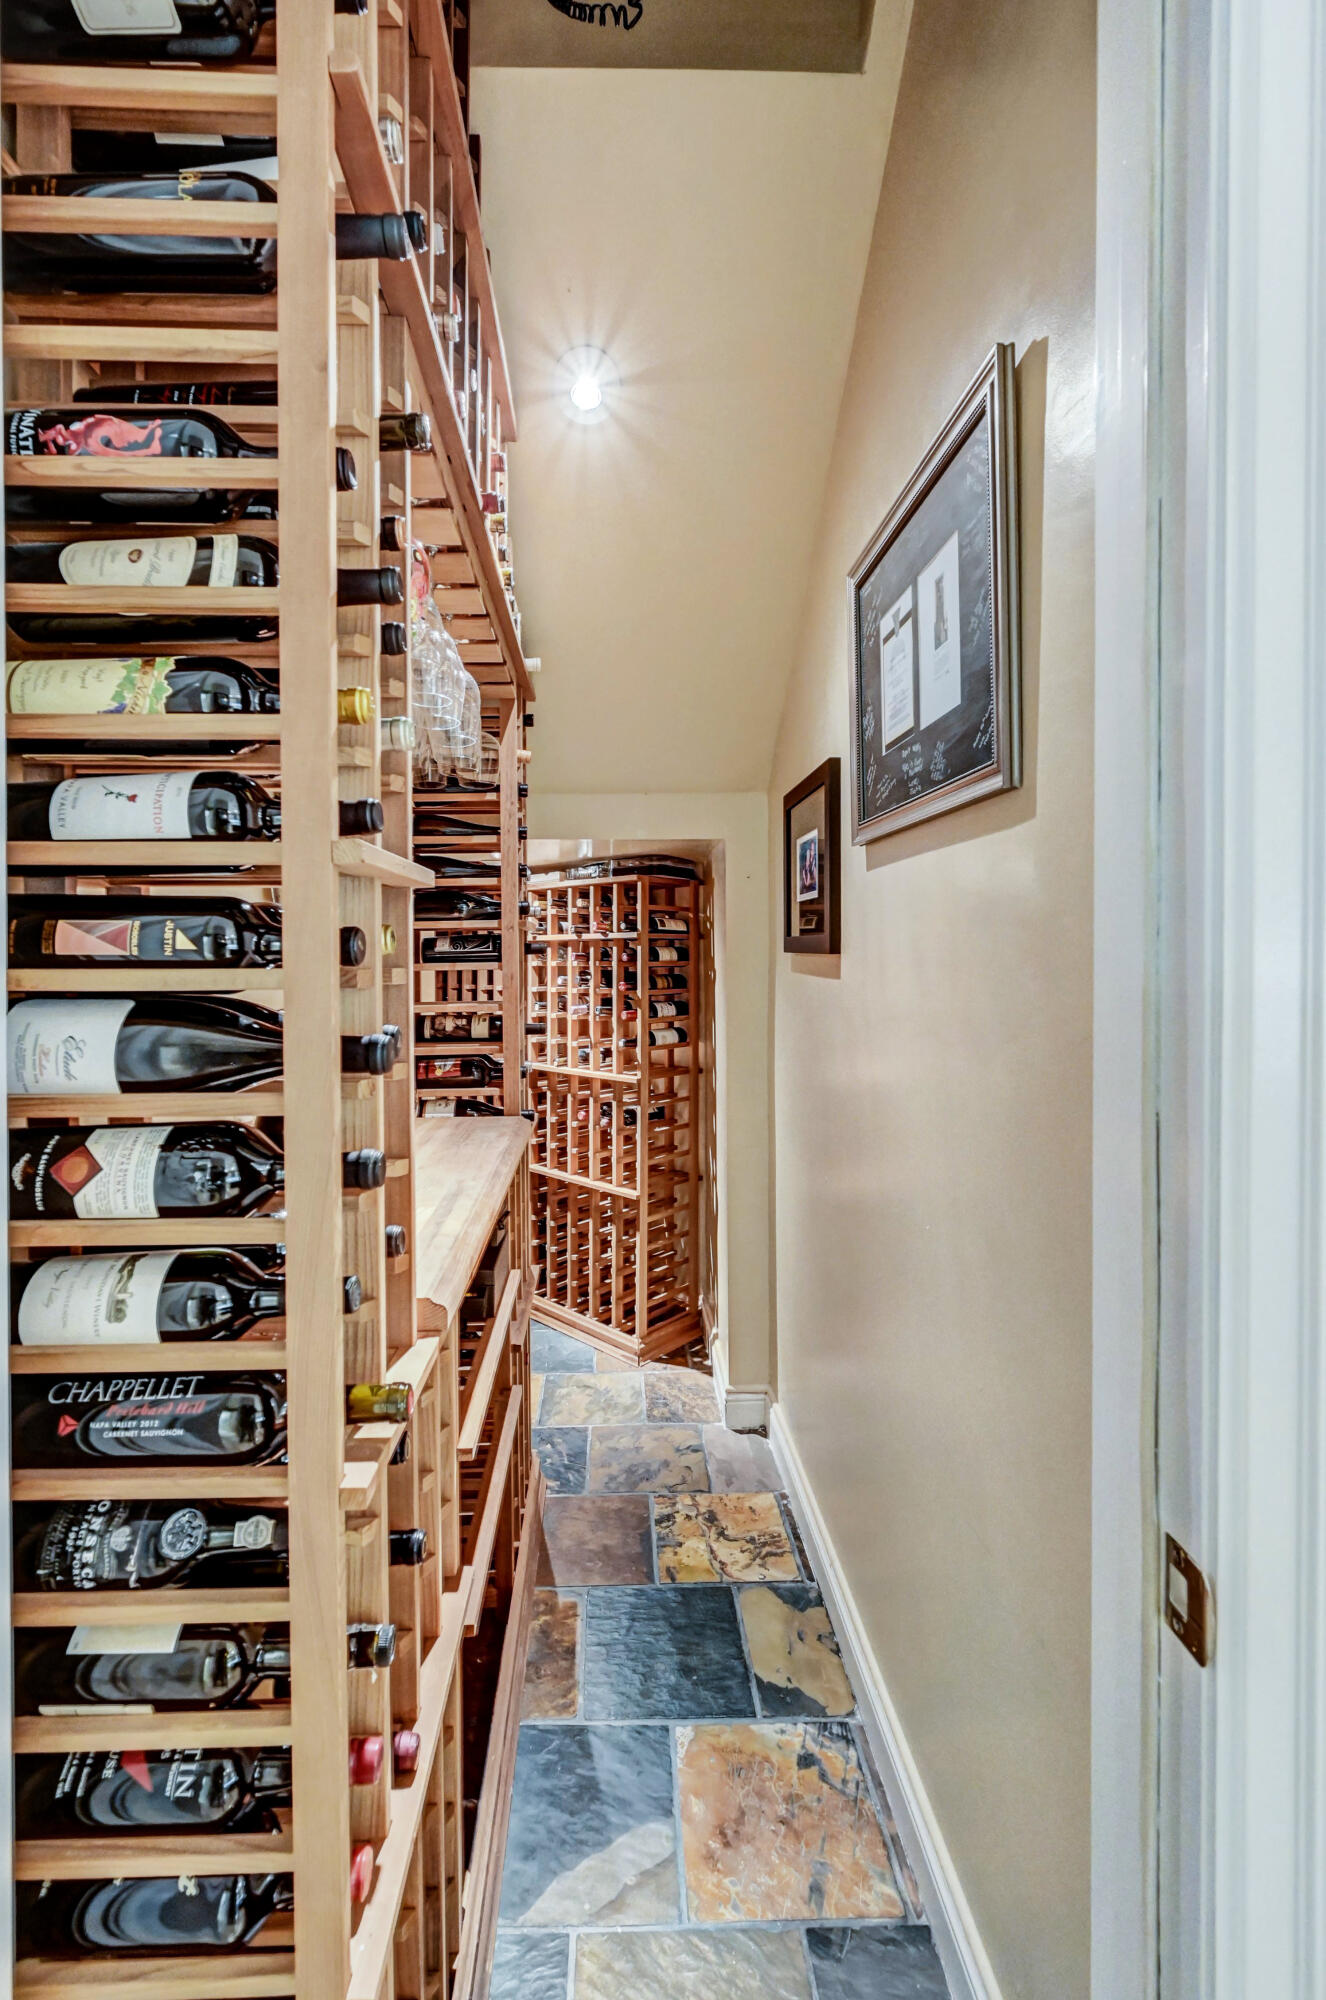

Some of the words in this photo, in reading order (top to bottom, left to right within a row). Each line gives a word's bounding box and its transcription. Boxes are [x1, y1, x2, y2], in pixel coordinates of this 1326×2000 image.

[164, 920, 175, 956] JUSTIN
[48, 1376, 205, 1404] CHAPPELLET
[140, 1428, 184, 1437] SAUVIGNON
